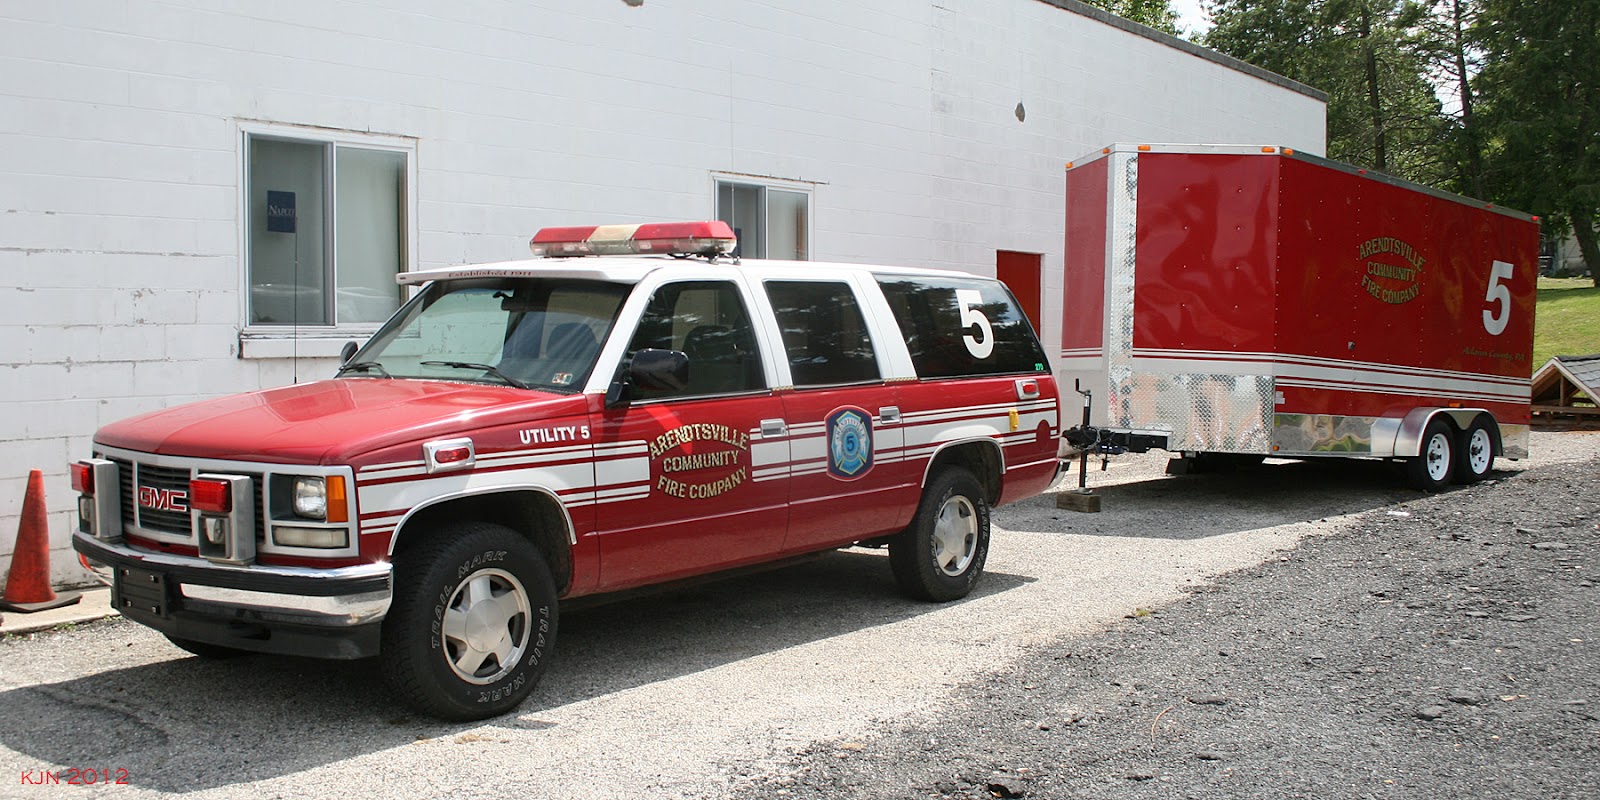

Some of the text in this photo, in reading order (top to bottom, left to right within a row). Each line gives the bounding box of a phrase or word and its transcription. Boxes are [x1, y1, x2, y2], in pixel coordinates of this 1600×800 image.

[1360, 237, 1426, 272] ARENDTSVILLE
[448, 270, 507, 278] Established
[1367, 261, 1416, 282] COMMUNITY
[1361, 274, 1420, 304] FIRE COMPANY
[1482, 260, 1514, 336] 5
[955, 289, 994, 359] 5
[519, 425, 591, 444] UTILITY 5
[649, 423, 749, 460] ARENDTSVILLE
[846, 435, 855, 452] 5
[663, 450, 739, 472] COMMUNITY
[657, 465, 747, 499] FIRE COMPANY
[139, 485, 187, 512] GMC
[431, 550, 507, 649] TRAIL MARK
[477, 605, 549, 703] TRAIL MARK
